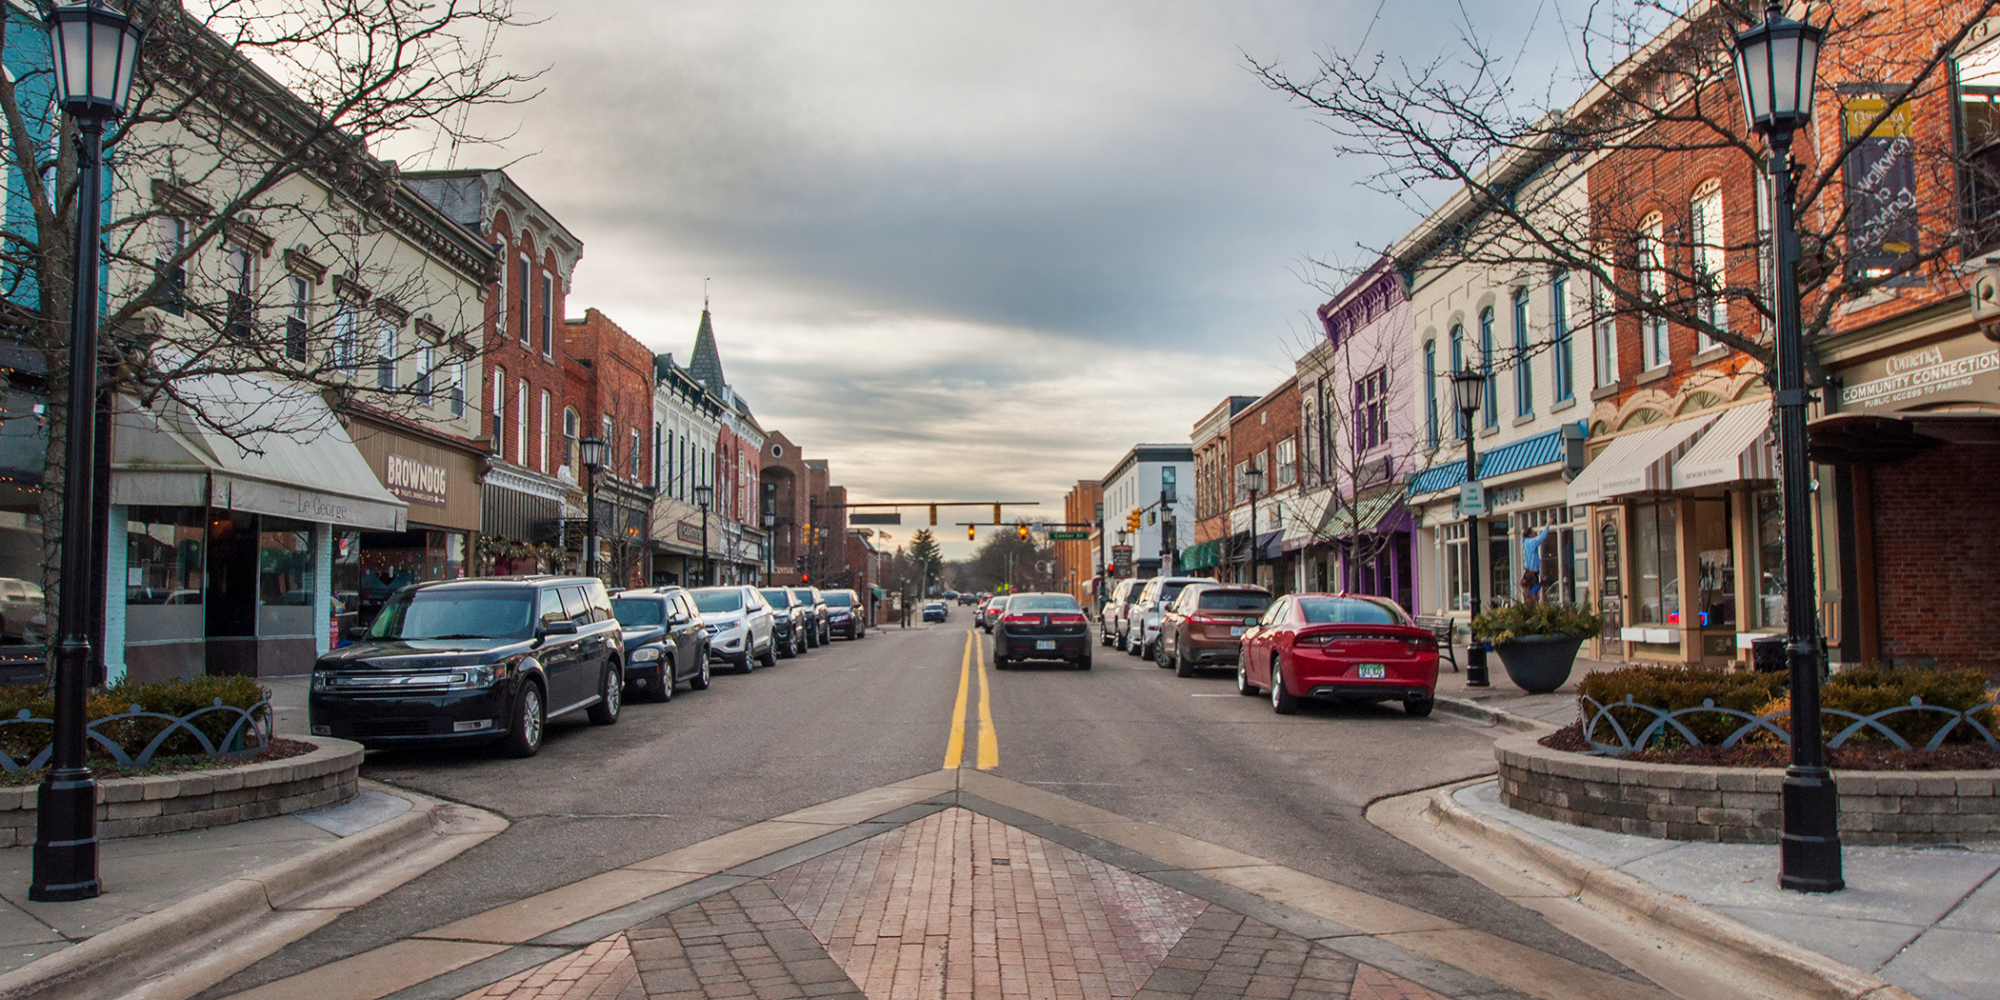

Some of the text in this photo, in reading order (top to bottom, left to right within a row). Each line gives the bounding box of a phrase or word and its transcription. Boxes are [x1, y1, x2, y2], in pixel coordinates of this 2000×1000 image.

[1843, 353, 2000, 401] COMMUNITY CONNECTION
[1864, 376, 1973, 408] PUBLIC ACCESS TO PARKING
[387, 455, 446, 495] BROWNDOG
[298, 493, 347, 522] Le George
